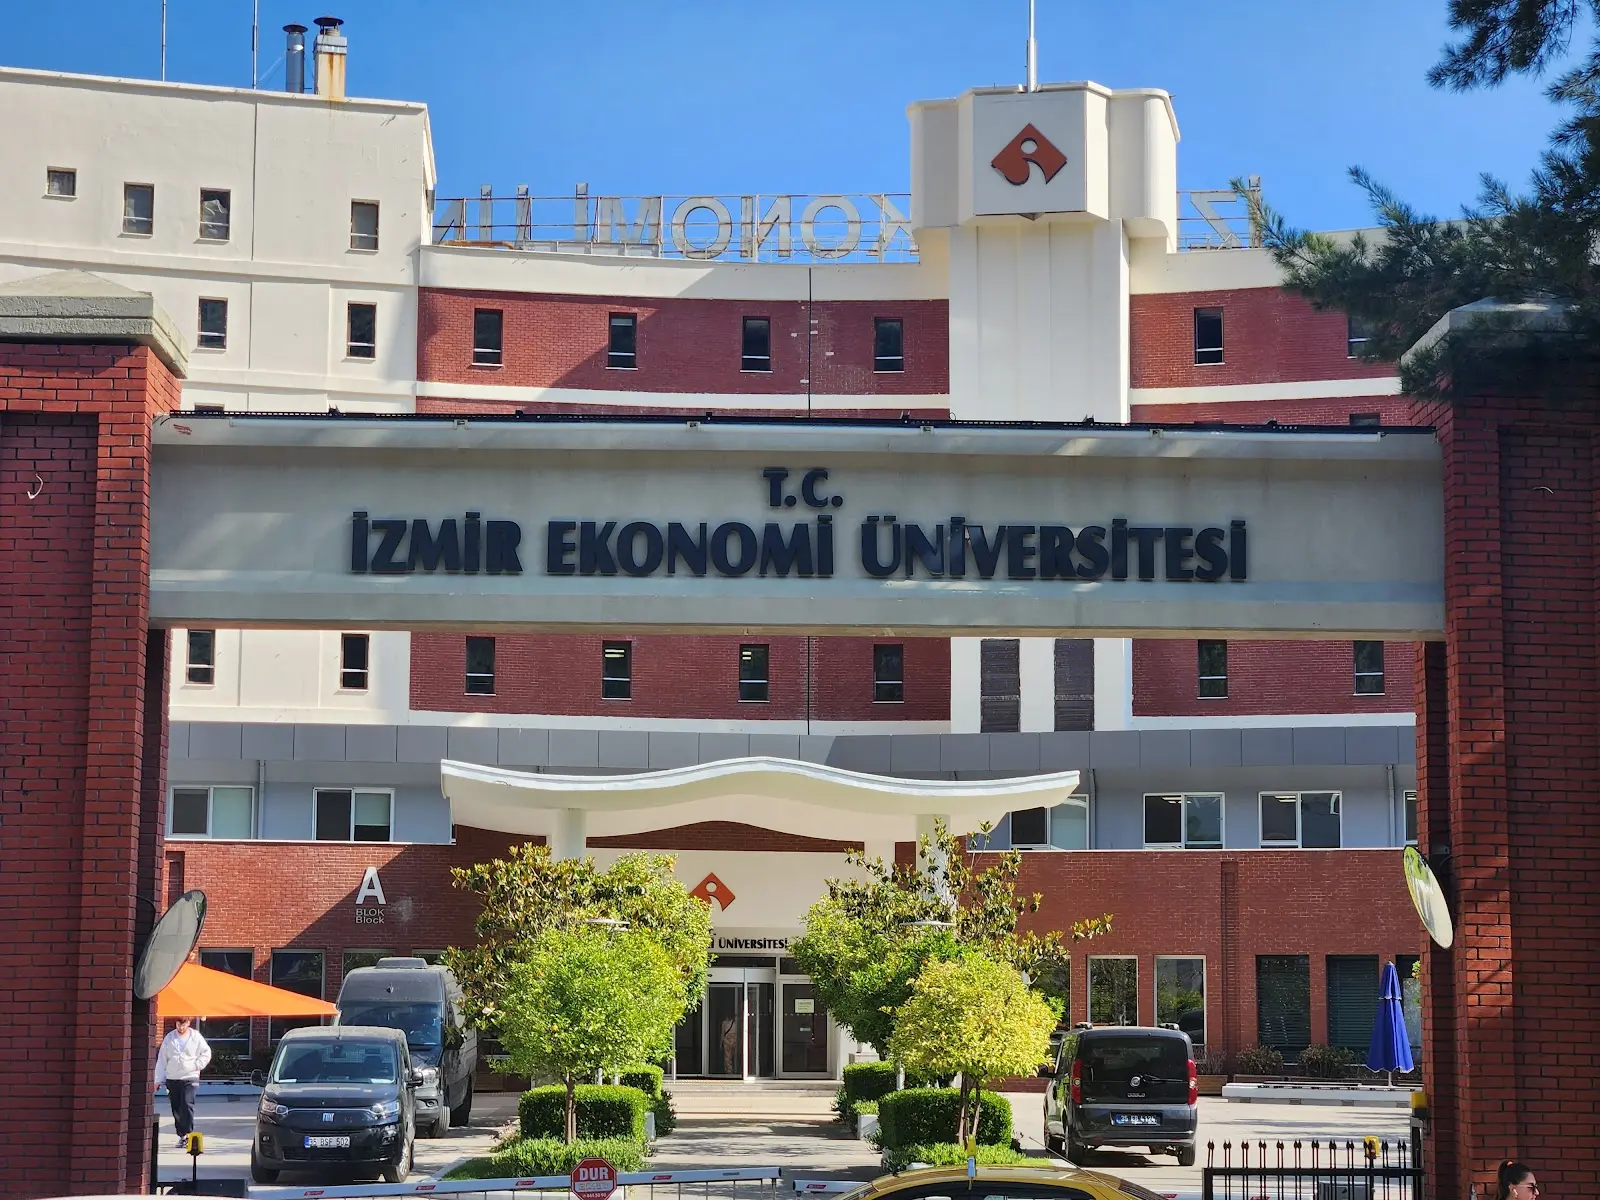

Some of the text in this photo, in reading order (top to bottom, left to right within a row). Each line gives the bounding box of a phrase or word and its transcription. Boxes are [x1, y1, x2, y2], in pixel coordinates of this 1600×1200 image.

[763, 467, 844, 508] T.C.
[351, 511, 1247, 581] İZMİR EKONOMİ ÜNİVERSİTESİ
[355, 866, 387, 905] A
[355, 908, 385, 917] BLOK
[355, 916, 385, 924] Block
[336, 1137, 350, 1147] 502
[579, 1166, 609, 1180] DUR
